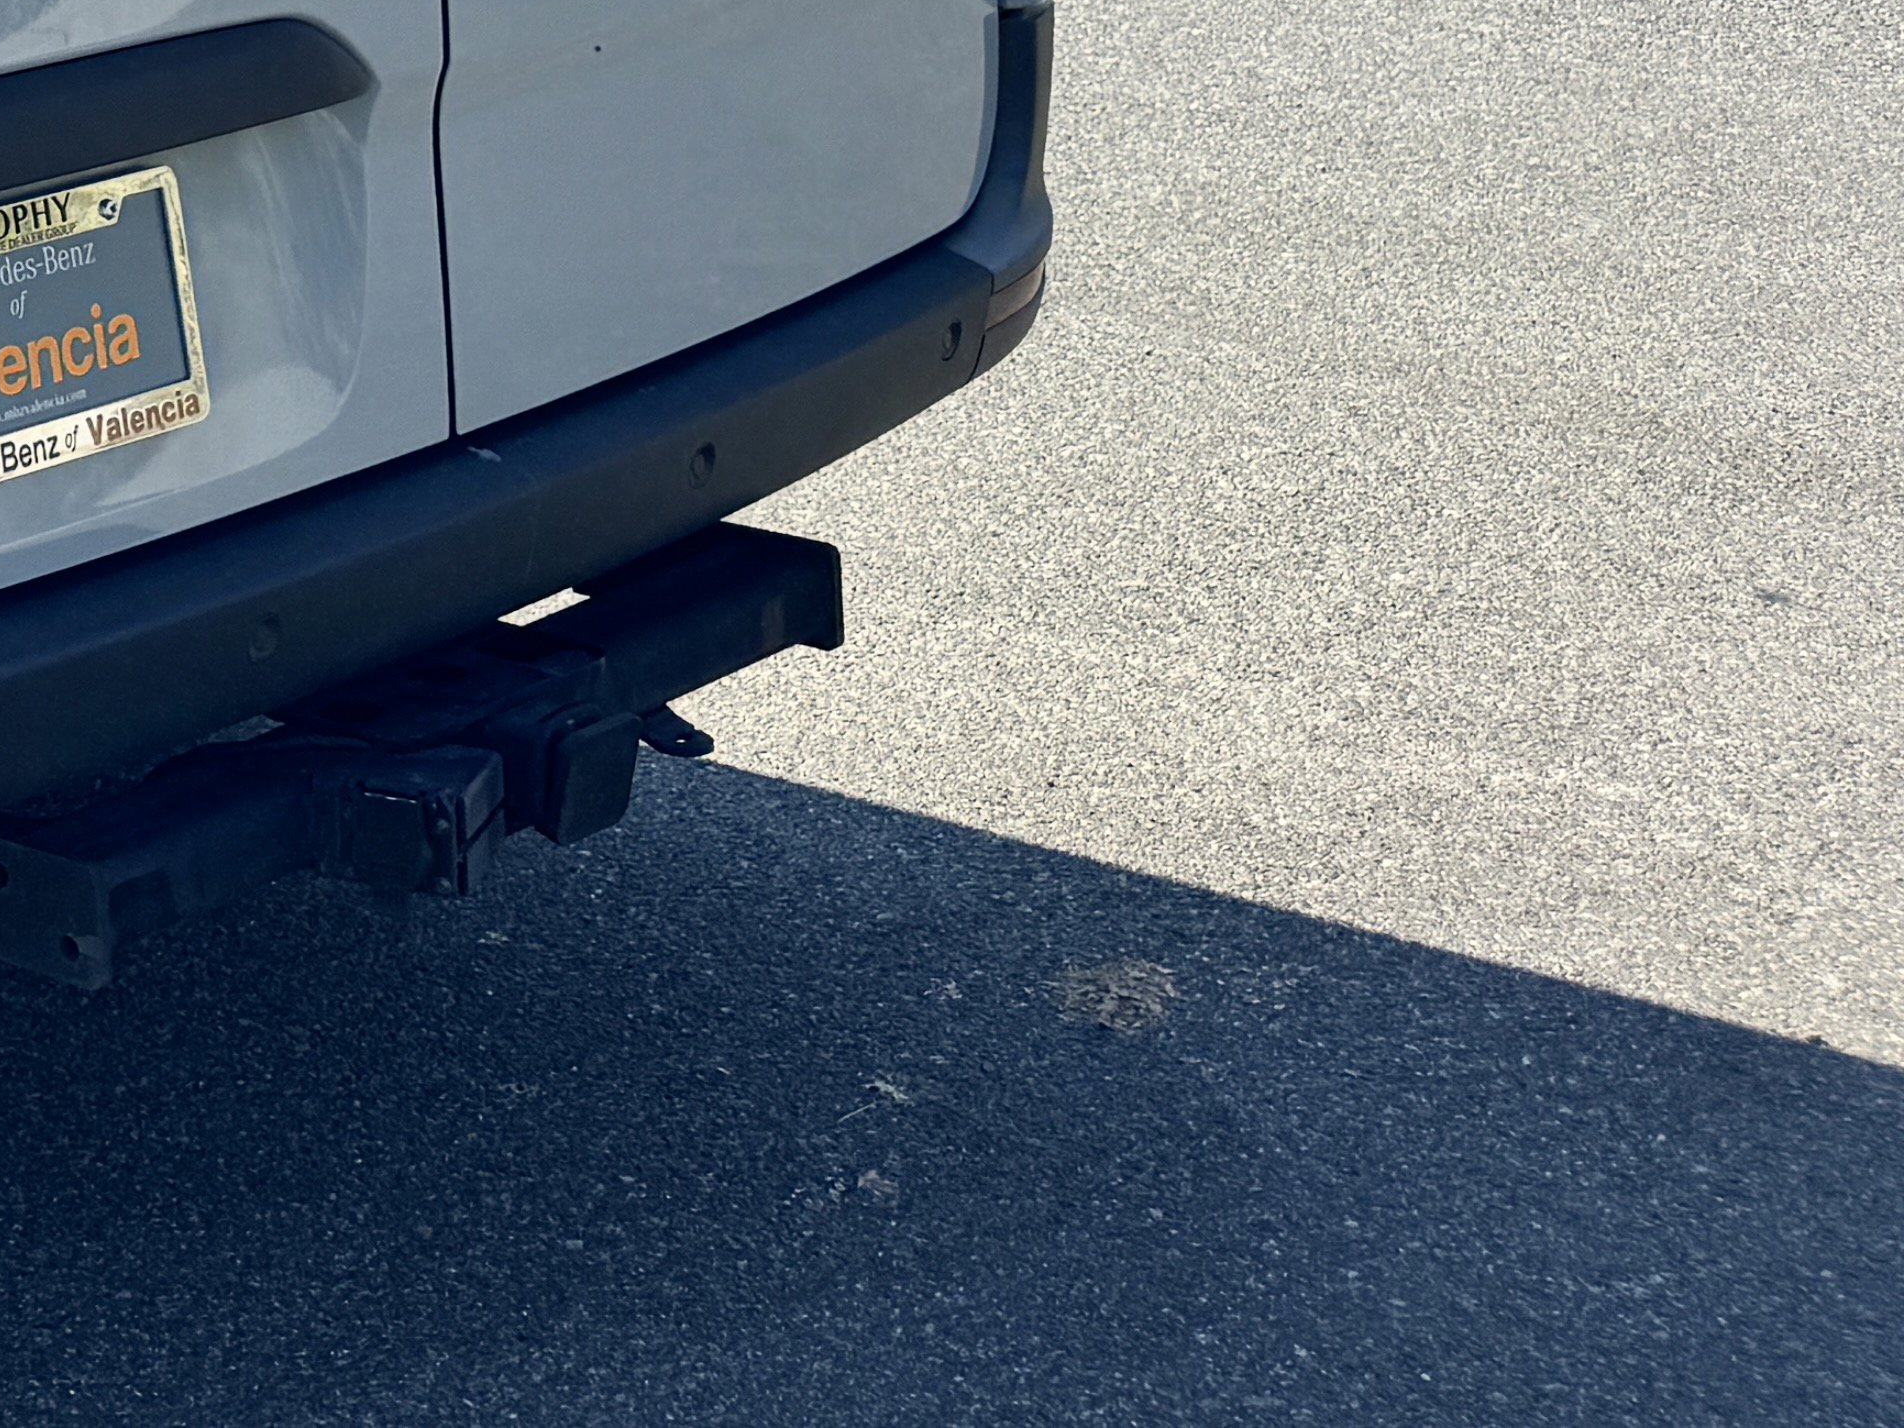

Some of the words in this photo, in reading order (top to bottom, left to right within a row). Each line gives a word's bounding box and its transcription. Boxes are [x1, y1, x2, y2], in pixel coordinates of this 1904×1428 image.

[8, 231, 44, 250] DEALER
[45, 220, 78, 241] GROUP
[9, 290, 28, 319] of
[64, 425, 80, 452] of
[85, 390, 201, 445] Valencia
